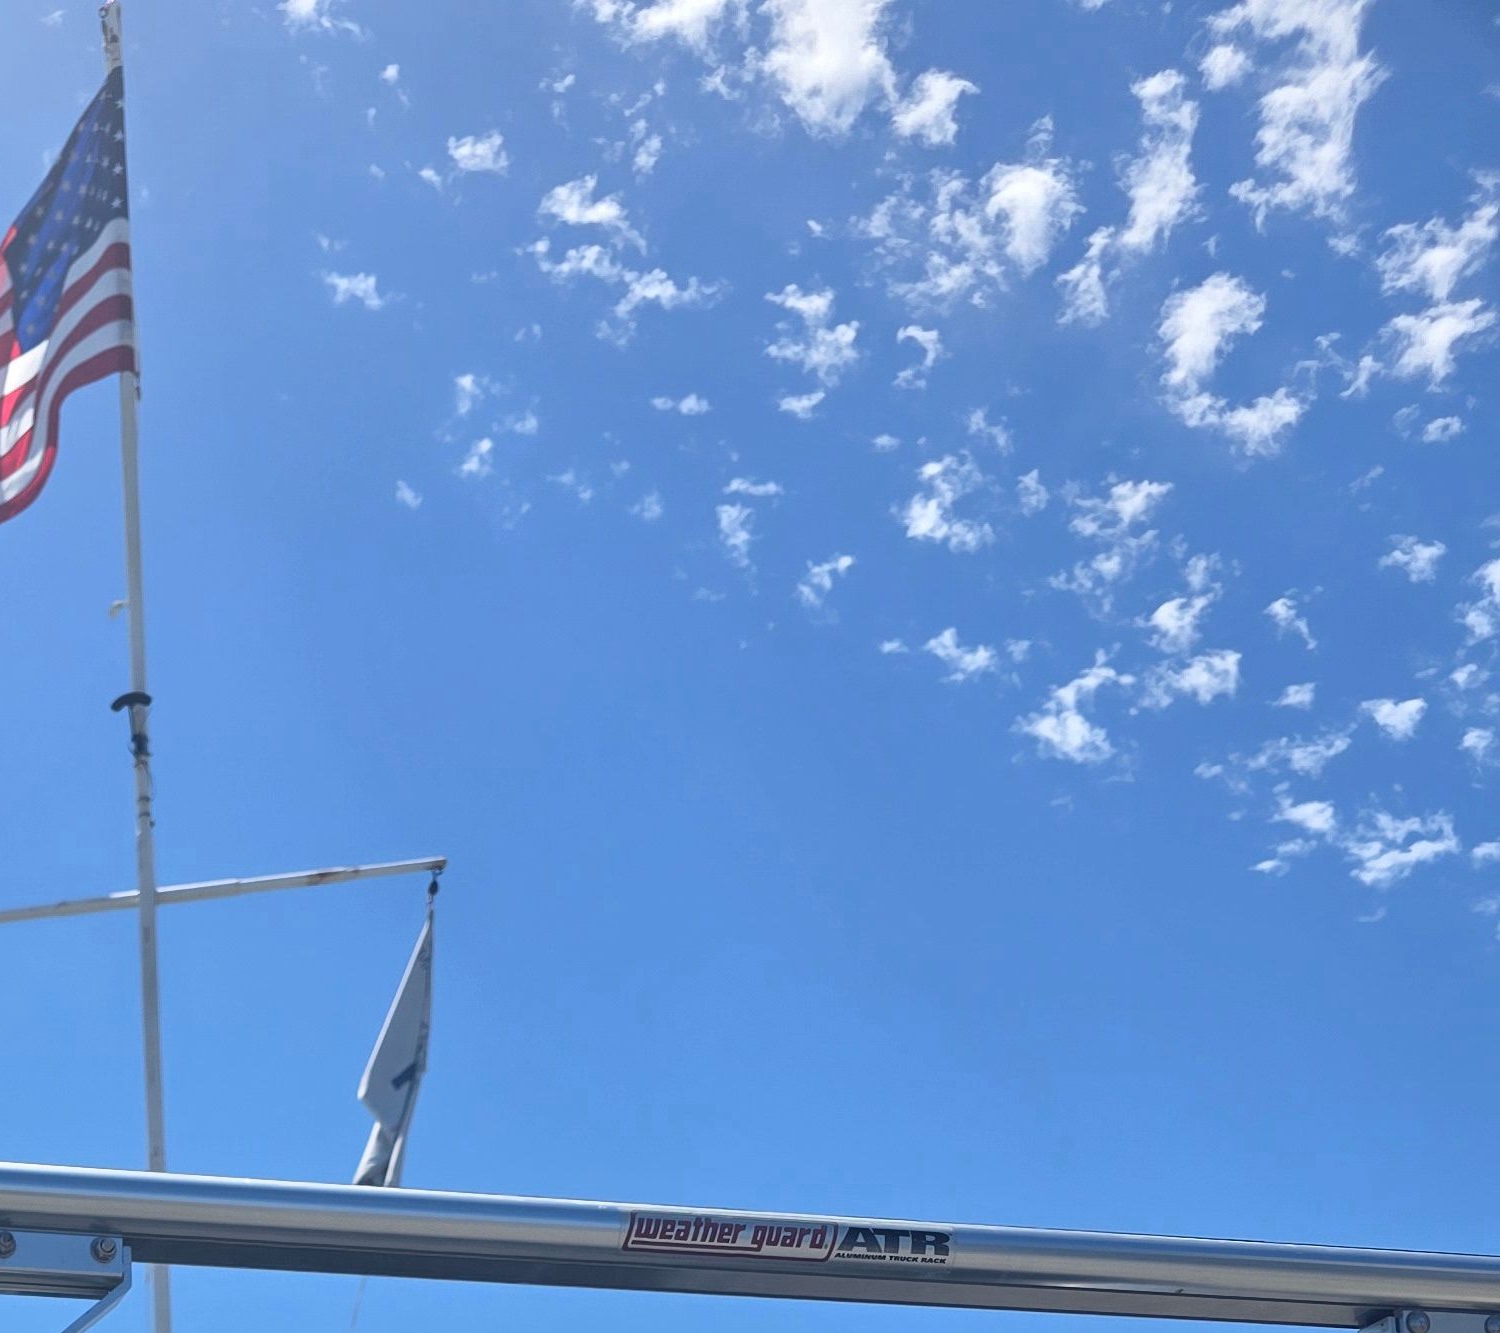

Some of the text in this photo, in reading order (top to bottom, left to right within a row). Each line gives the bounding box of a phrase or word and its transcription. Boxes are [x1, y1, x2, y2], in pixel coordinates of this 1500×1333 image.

[634, 1216, 828, 1250] weather guard
[837, 1227, 950, 1256] ATR
[835, 1252, 887, 1261] ALUMINUM
[889, 1255, 918, 1263] TRUCK
